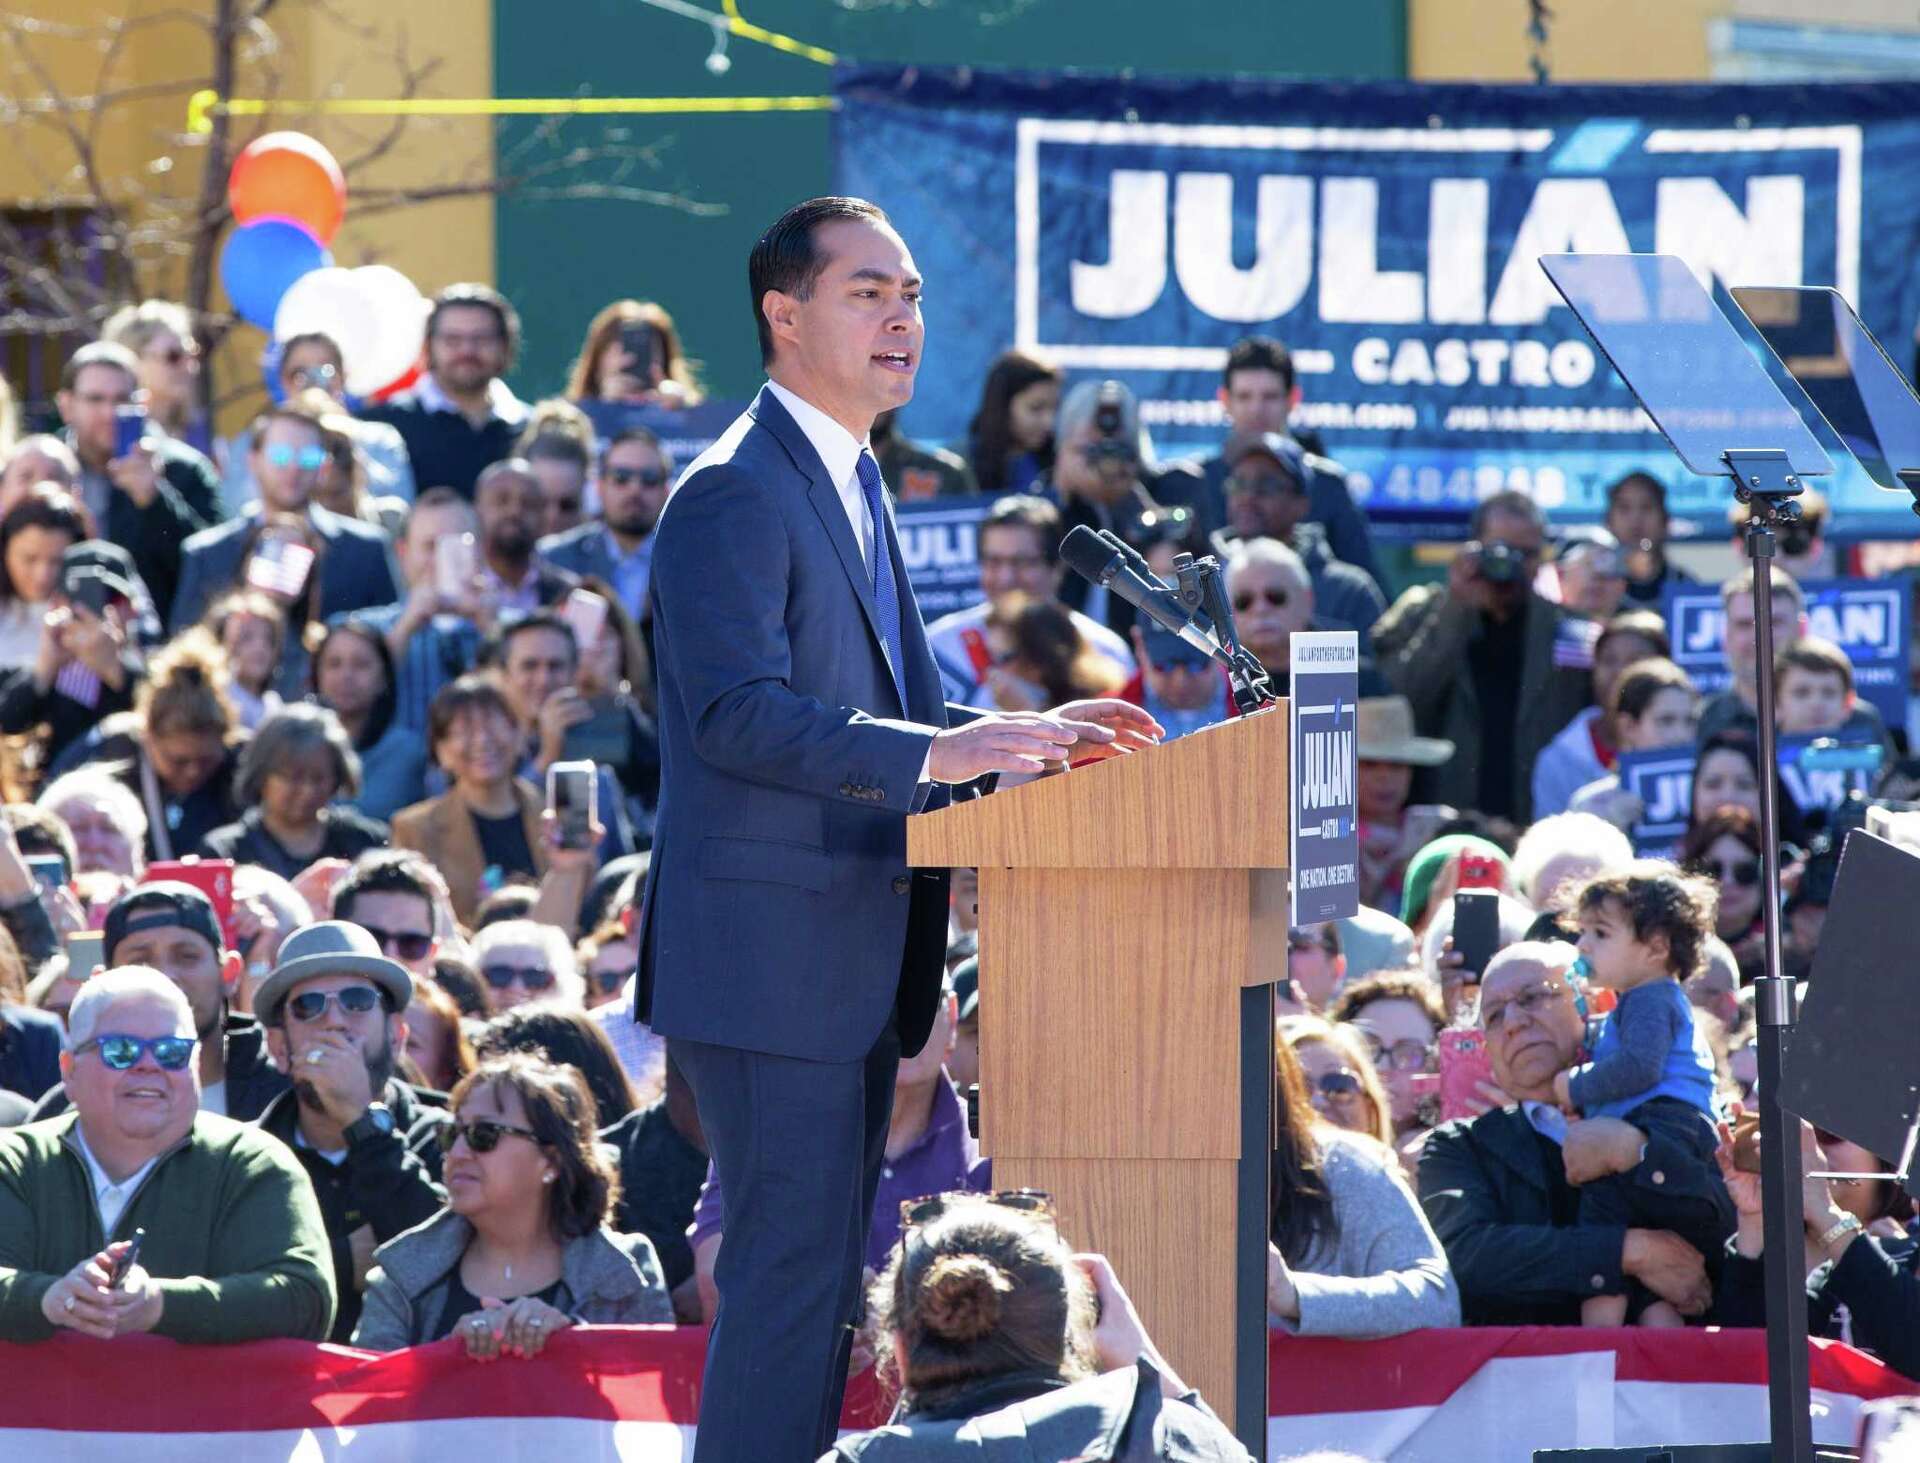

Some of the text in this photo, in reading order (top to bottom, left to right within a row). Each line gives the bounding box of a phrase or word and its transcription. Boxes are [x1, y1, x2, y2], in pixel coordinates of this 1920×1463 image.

[1351, 338, 1596, 387] CASTRO
[1322, 818, 1339, 839] CASTRO
[1300, 863, 1356, 890] ONE NATION. ONE DESTINY.
